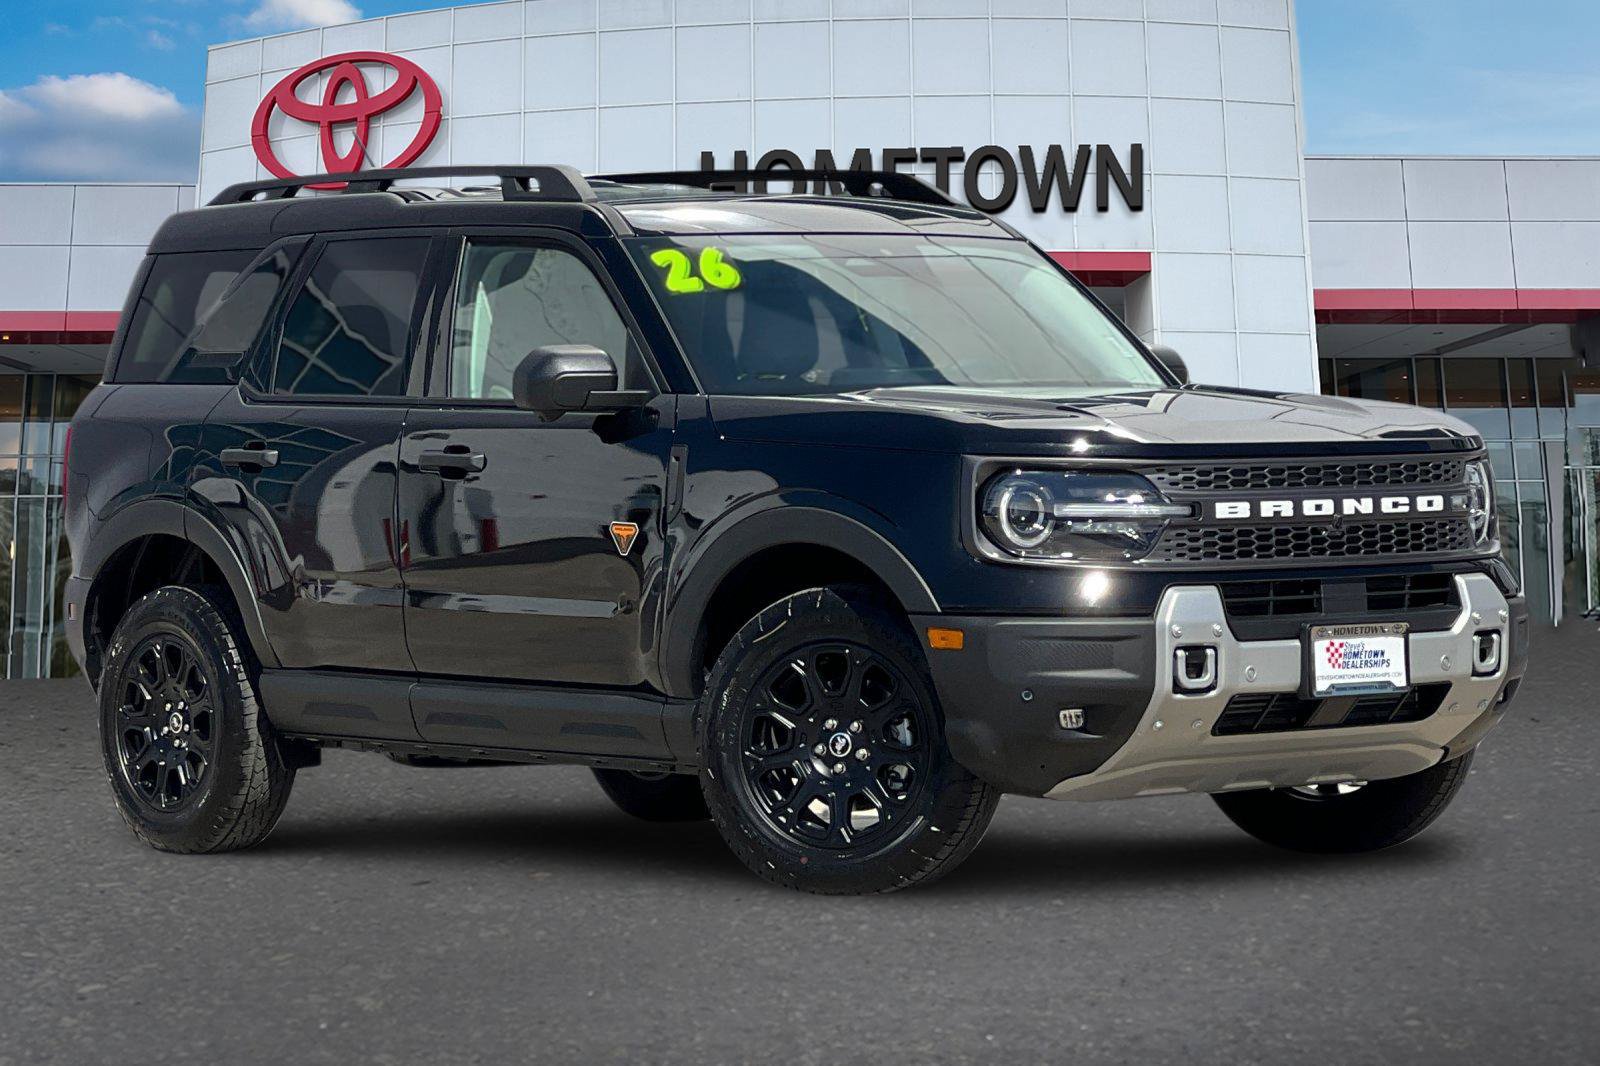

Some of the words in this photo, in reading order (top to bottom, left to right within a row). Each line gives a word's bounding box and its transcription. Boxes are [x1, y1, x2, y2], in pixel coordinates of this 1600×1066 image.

[650, 246, 741, 293] 26
[1214, 494, 1444, 519] BRONCO
[1333, 625, 1386, 636] HOMETOWN
[1344, 641, 1366, 651] Steve's
[1343, 649, 1386, 659] HOMETOWN
[1342, 659, 1391, 669] DEALERSHIPS
